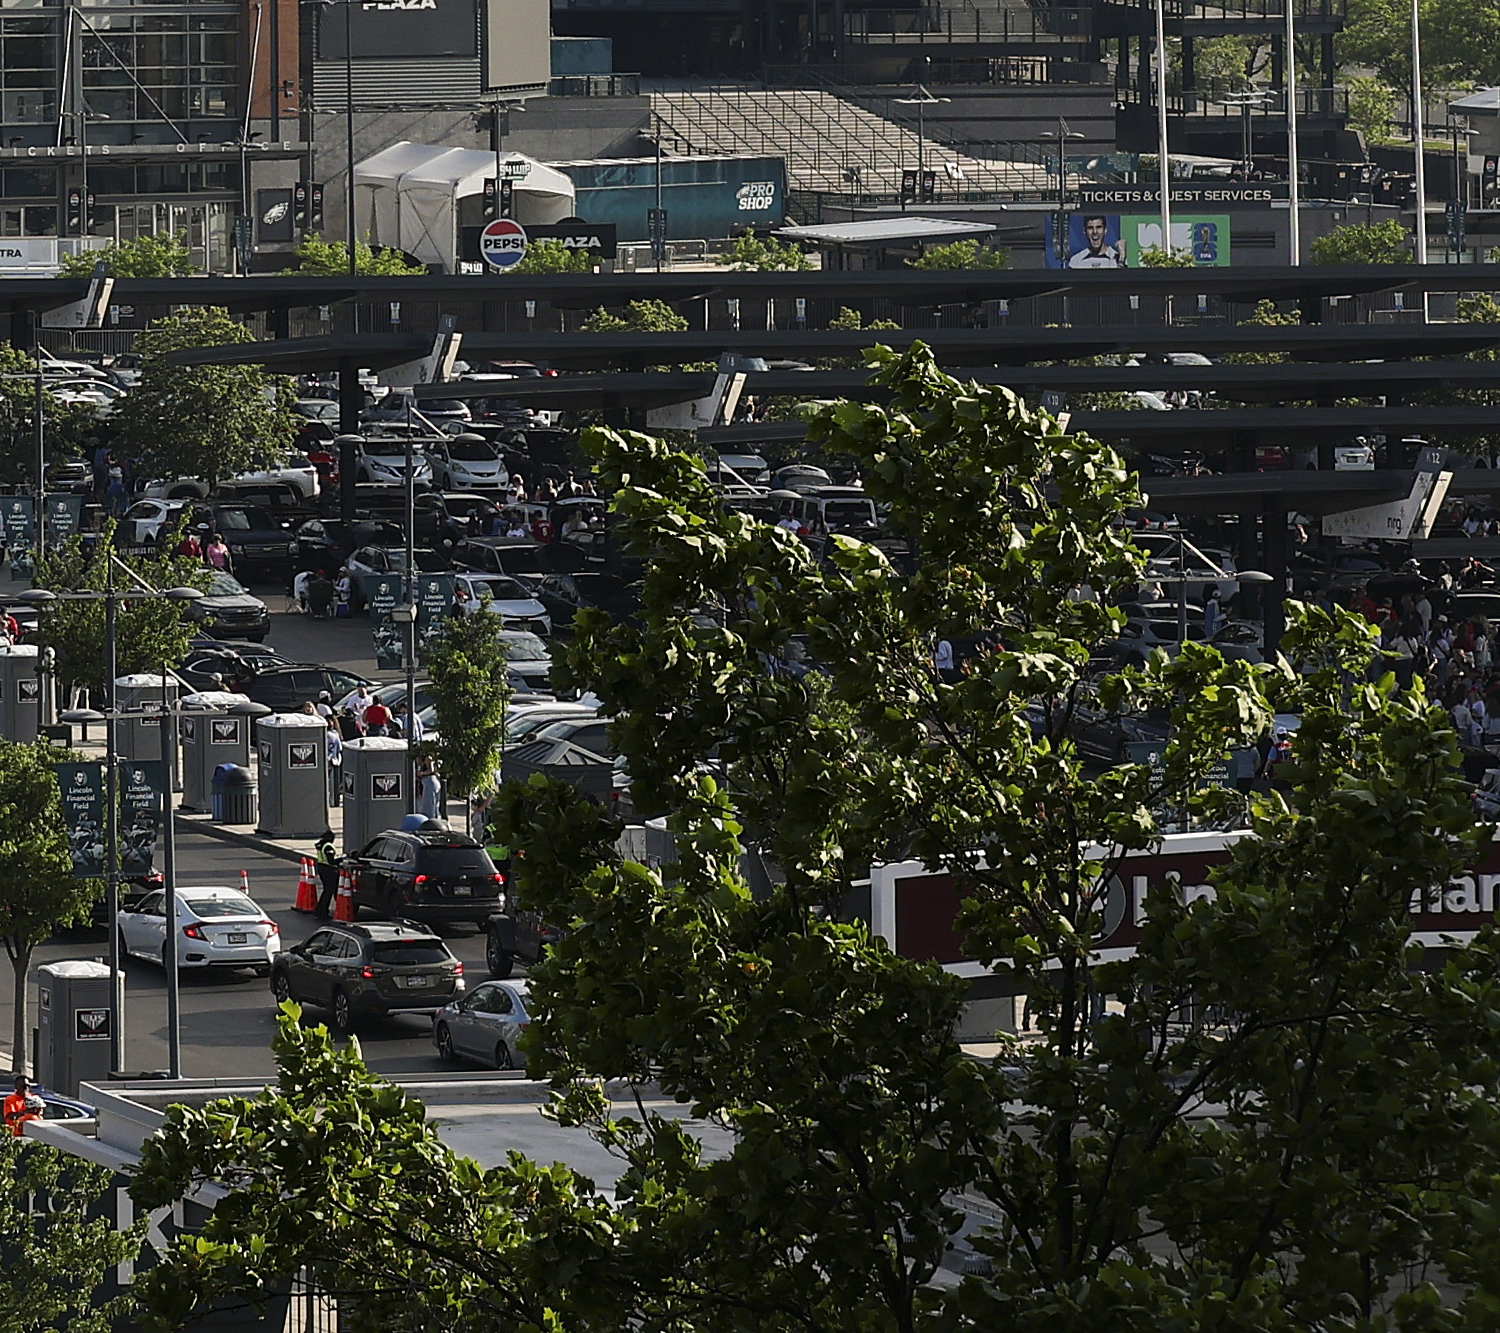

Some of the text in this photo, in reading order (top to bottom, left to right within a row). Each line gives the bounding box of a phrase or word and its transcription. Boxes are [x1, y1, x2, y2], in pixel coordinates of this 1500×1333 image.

[749, 185, 775, 197] PRO
[1082, 190, 1141, 202] TICKETS
[1142, 190, 1154, 202] &
[1204, 189, 1272, 201] SERVICES
[738, 196, 773, 211] SHOP
[484, 239, 525, 249] PEPSI
